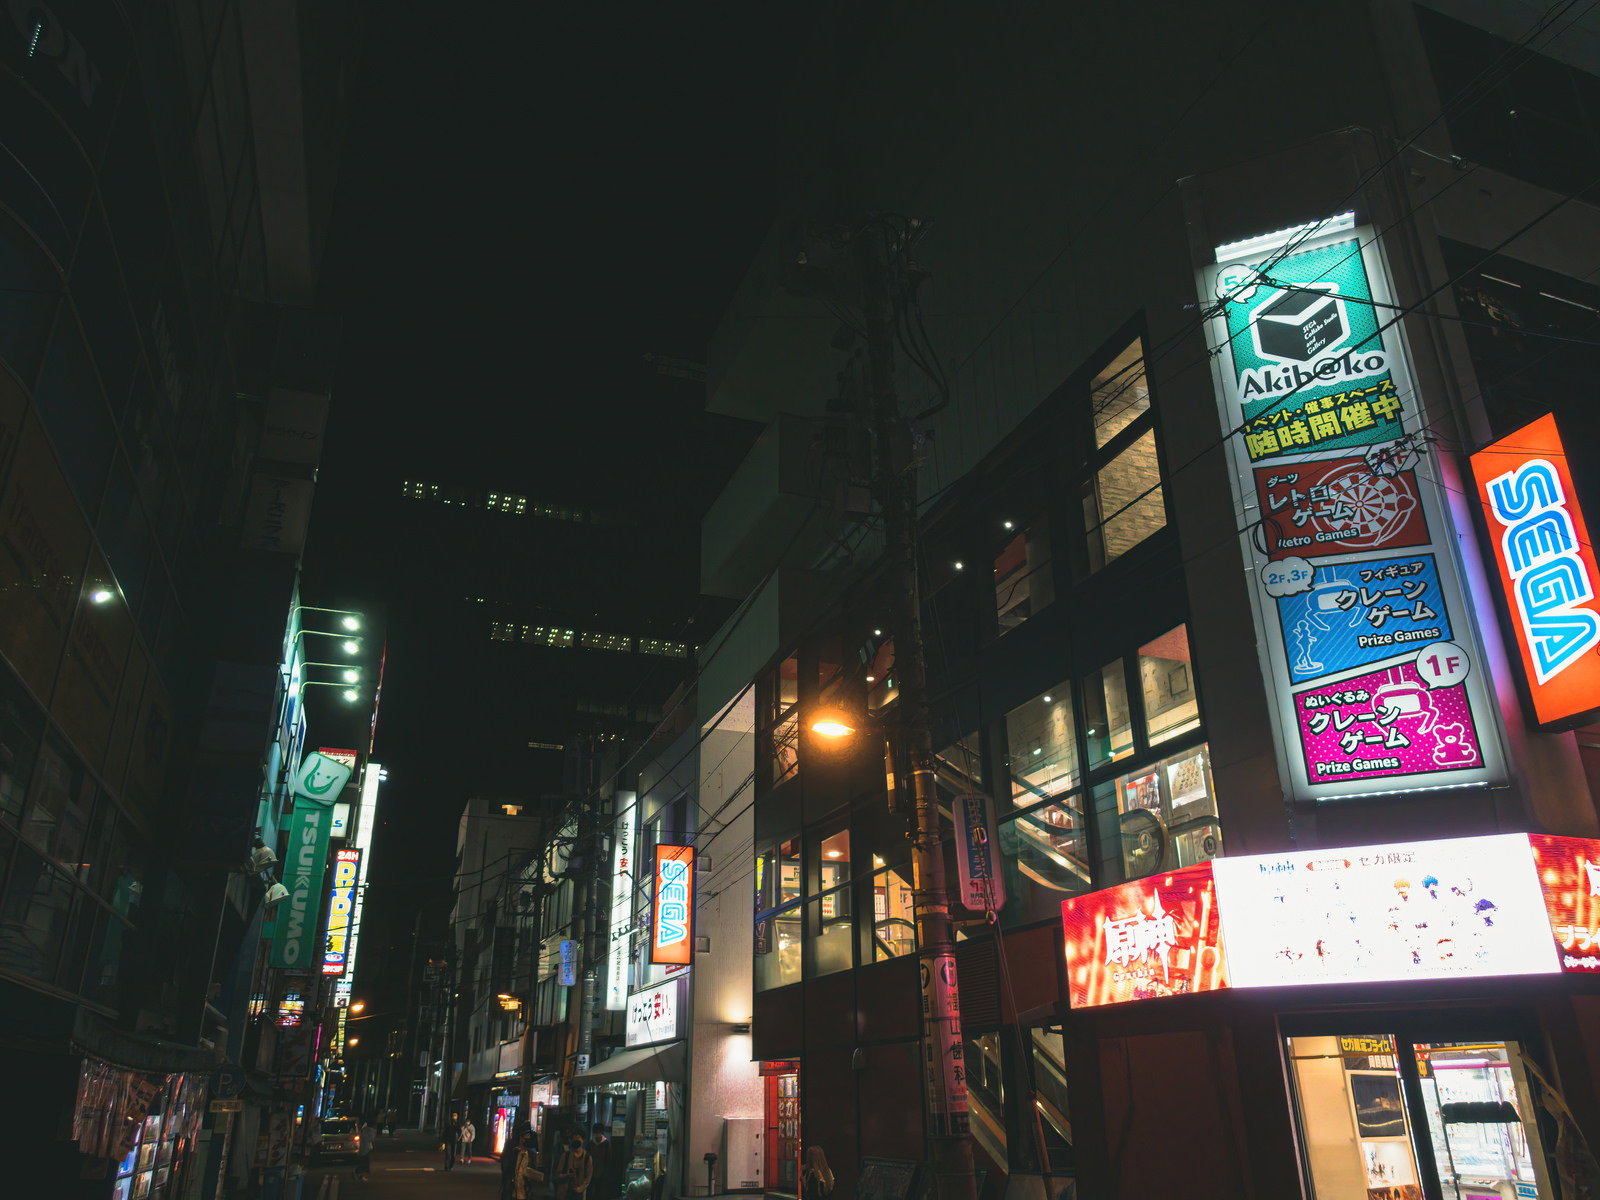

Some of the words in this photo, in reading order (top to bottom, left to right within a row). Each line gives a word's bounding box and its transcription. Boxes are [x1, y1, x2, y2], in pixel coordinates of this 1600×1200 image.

[1303, 320, 1317, 333] SEGA
[1323, 312, 1338, 326] Studio
[1306, 336, 1316, 348] and
[1307, 337, 1326, 355] Gallery
[1243, 355, 1385, 399] Akib@ko
[1246, 395, 1401, 459] 随時開催中
[1267, 473, 1299, 488] ダーツ
[1268, 485, 1330, 511] レトロ
[1292, 501, 1355, 527] ゲーム
[1315, 527, 1358, 543] Games
[1359, 562, 1424, 582] フィギュア
[1488, 461, 1600, 683] SEGA
[1337, 581, 1428, 611] クレーン
[1367, 602, 1437, 628] ゲーム
[1358, 634, 1393, 648] Prize
[1394, 627, 1441, 645] Games
[1305, 690, 1370, 708] ぬいぐるみ
[1308, 704, 1401, 734] クレーン
[1339, 727, 1410, 755] ゲーム
[1316, 761, 1351, 775] Prize
[1352, 756, 1400, 772] Games
[337, 851, 359, 861] 24H
[283, 811, 320, 965] TSUKUMO
[659, 860, 687, 947] SEGA
[1103, 888, 1176, 984] 原神
